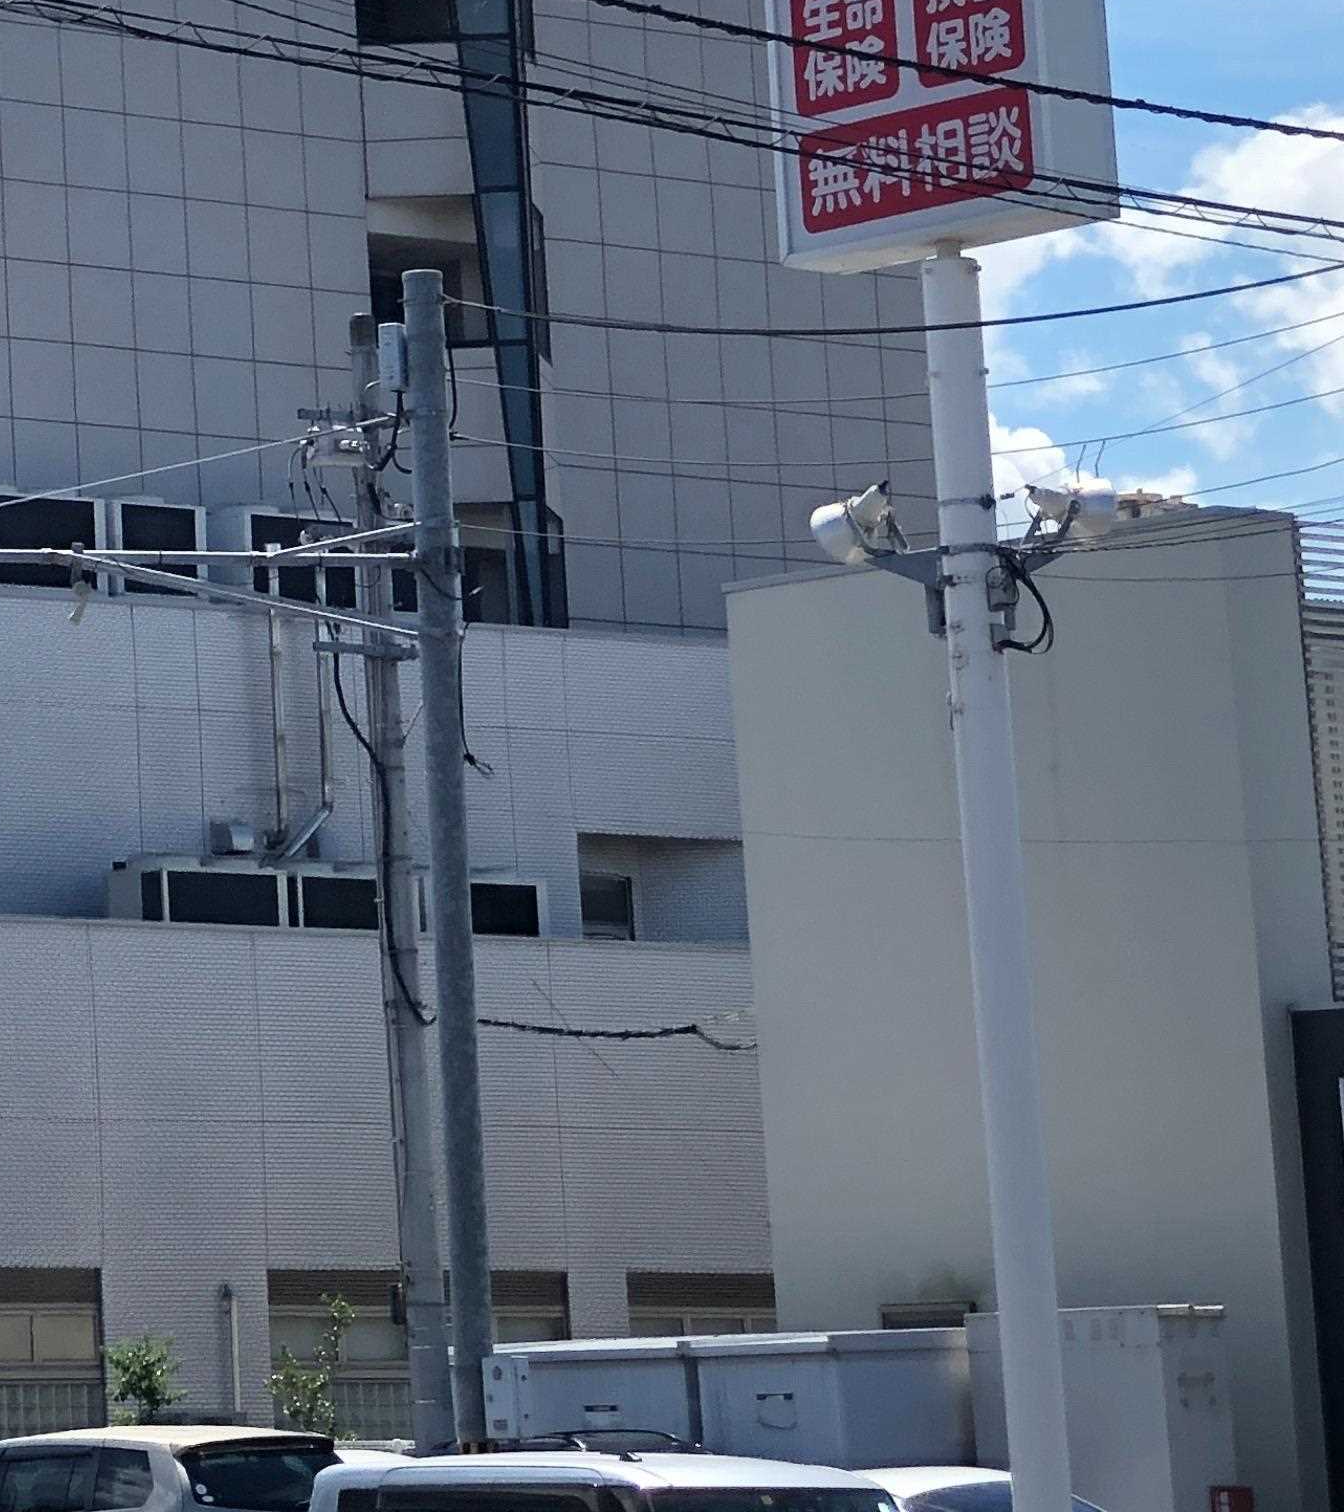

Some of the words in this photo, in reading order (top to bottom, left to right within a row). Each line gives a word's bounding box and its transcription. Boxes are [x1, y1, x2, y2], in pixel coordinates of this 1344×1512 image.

[925, 7, 1013, 72] 保険
[808, 105, 1025, 218] 無料相談
